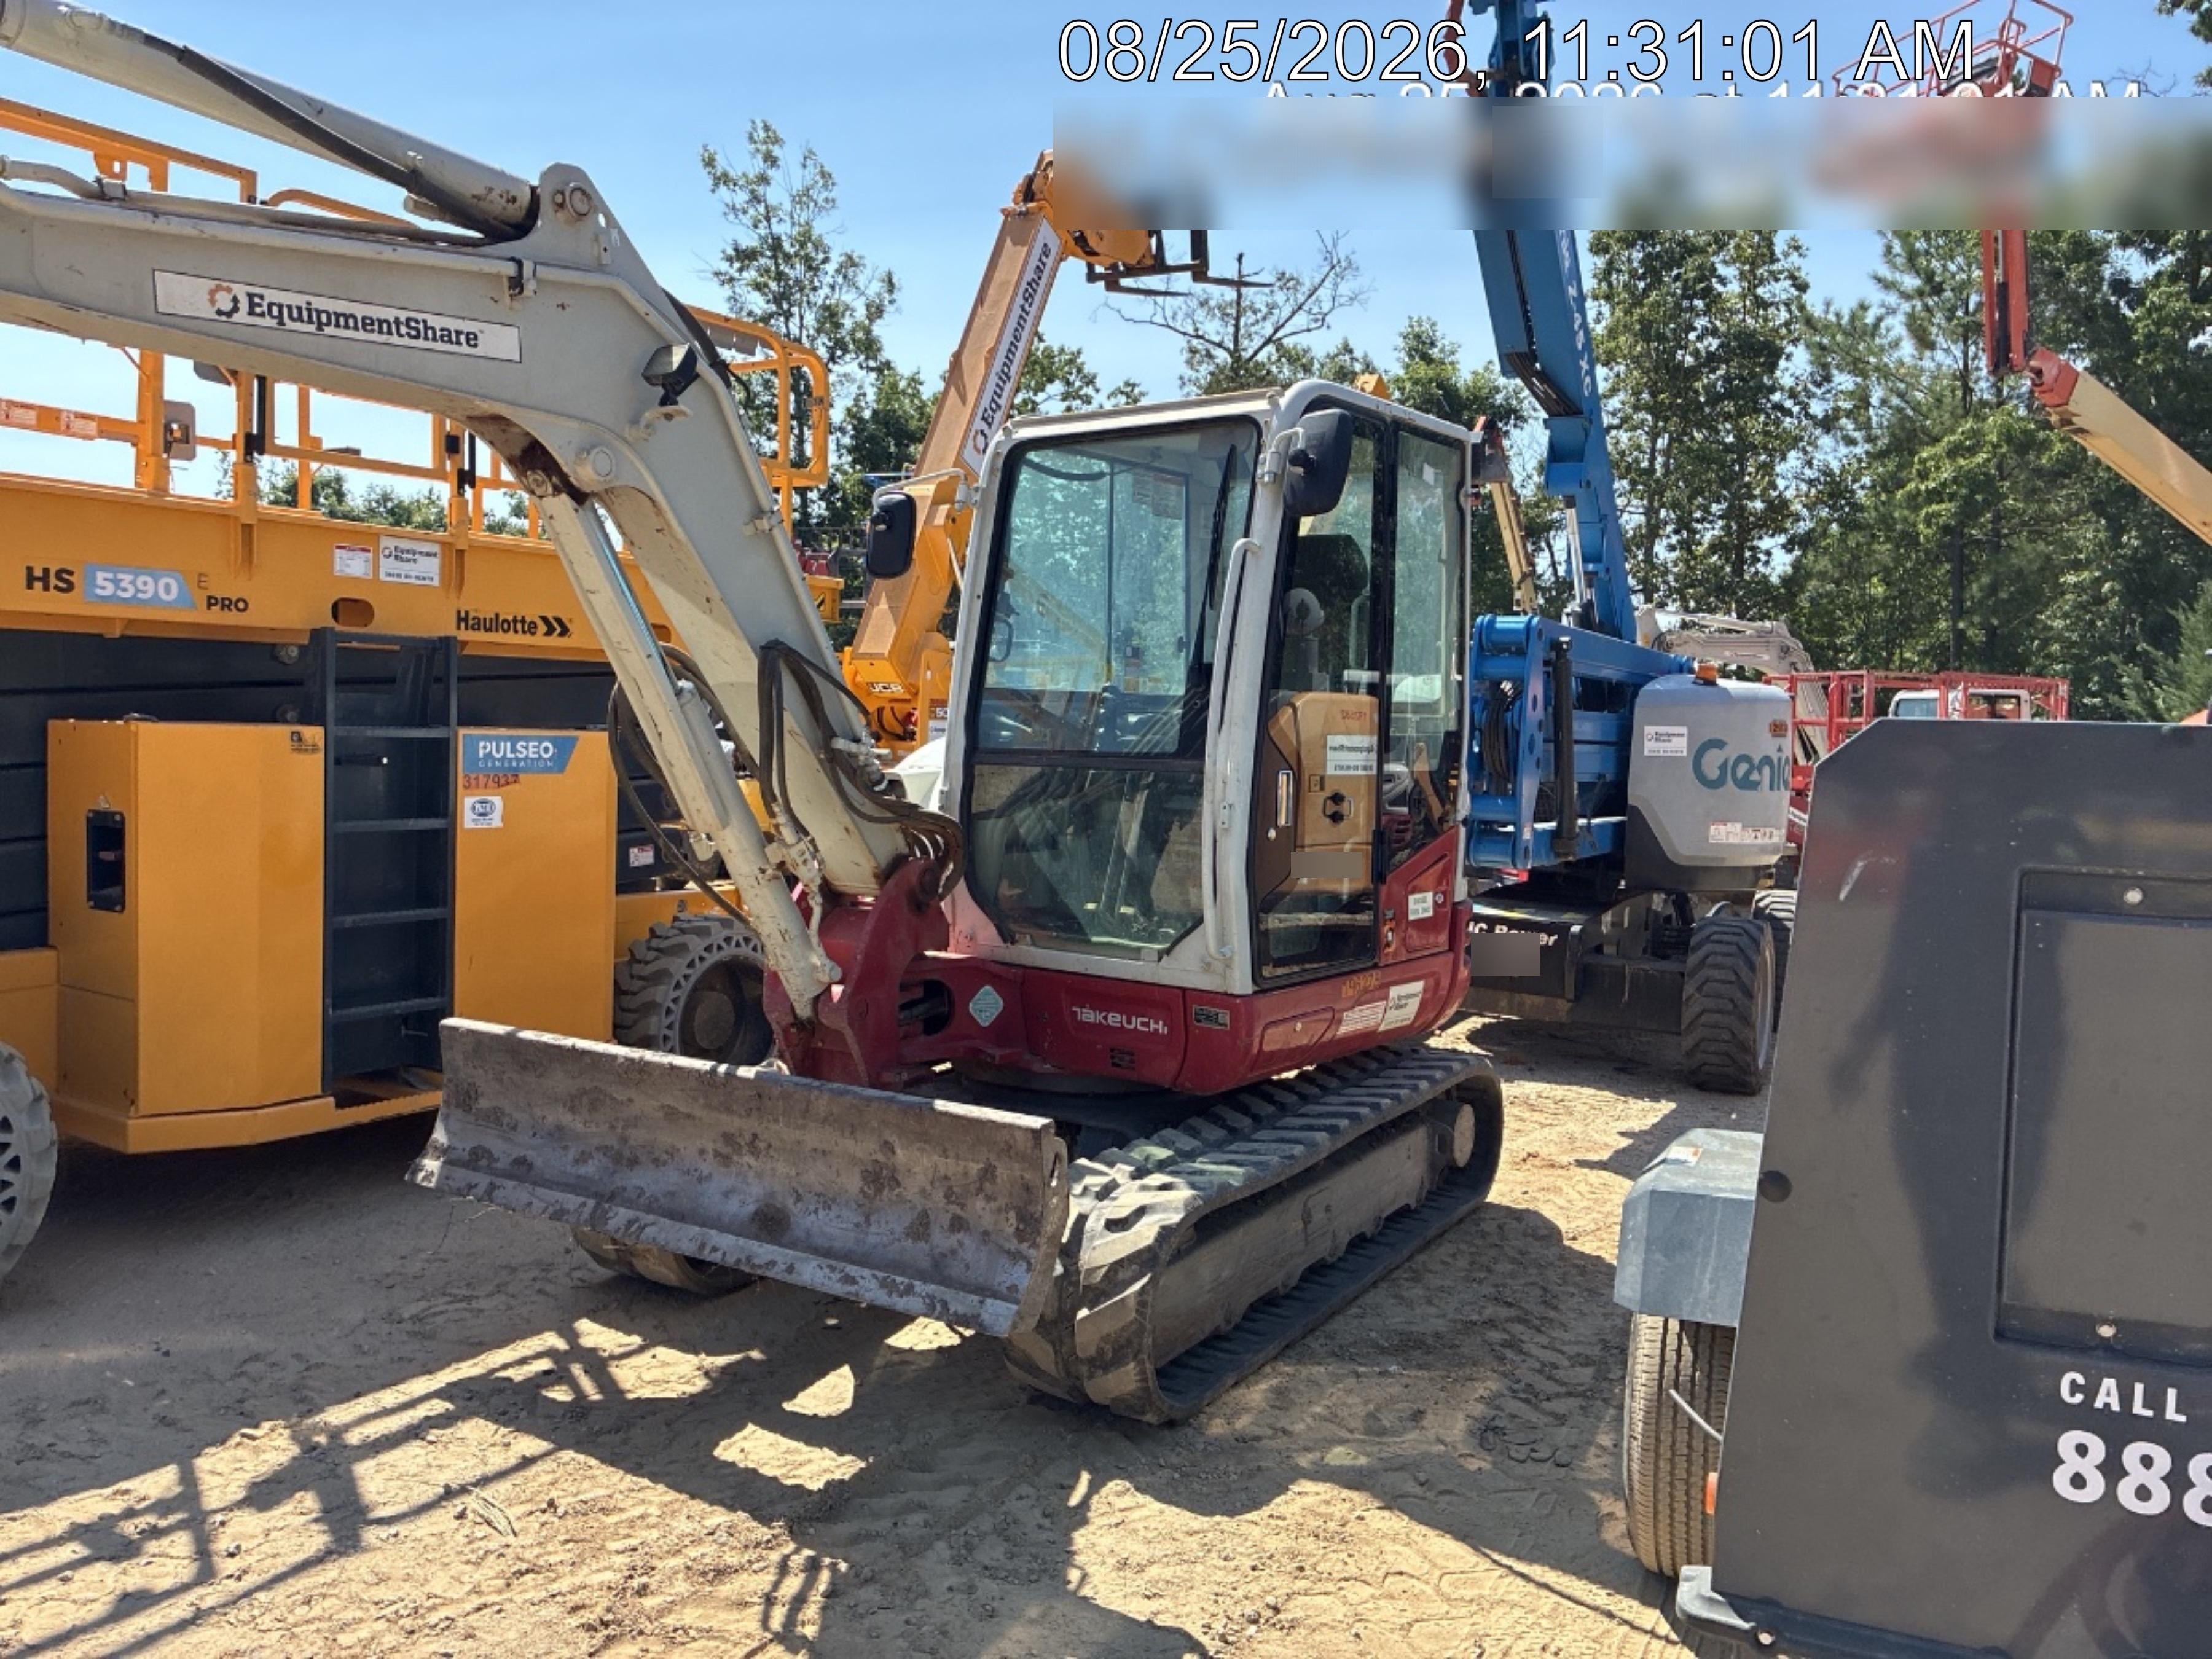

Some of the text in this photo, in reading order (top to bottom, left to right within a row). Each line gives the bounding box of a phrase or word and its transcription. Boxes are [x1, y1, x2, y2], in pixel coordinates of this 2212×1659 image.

[246, 292, 479, 348] EquipmentShare
[981, 243, 1051, 429] EquipmentShare
[25, 565, 210, 602] HS 5390 E
[206, 595, 249, 613] PRO
[457, 610, 538, 636] Haulotte
[479, 740, 554, 759] PULSEO
[2060, 1371, 2187, 1423] CALL
